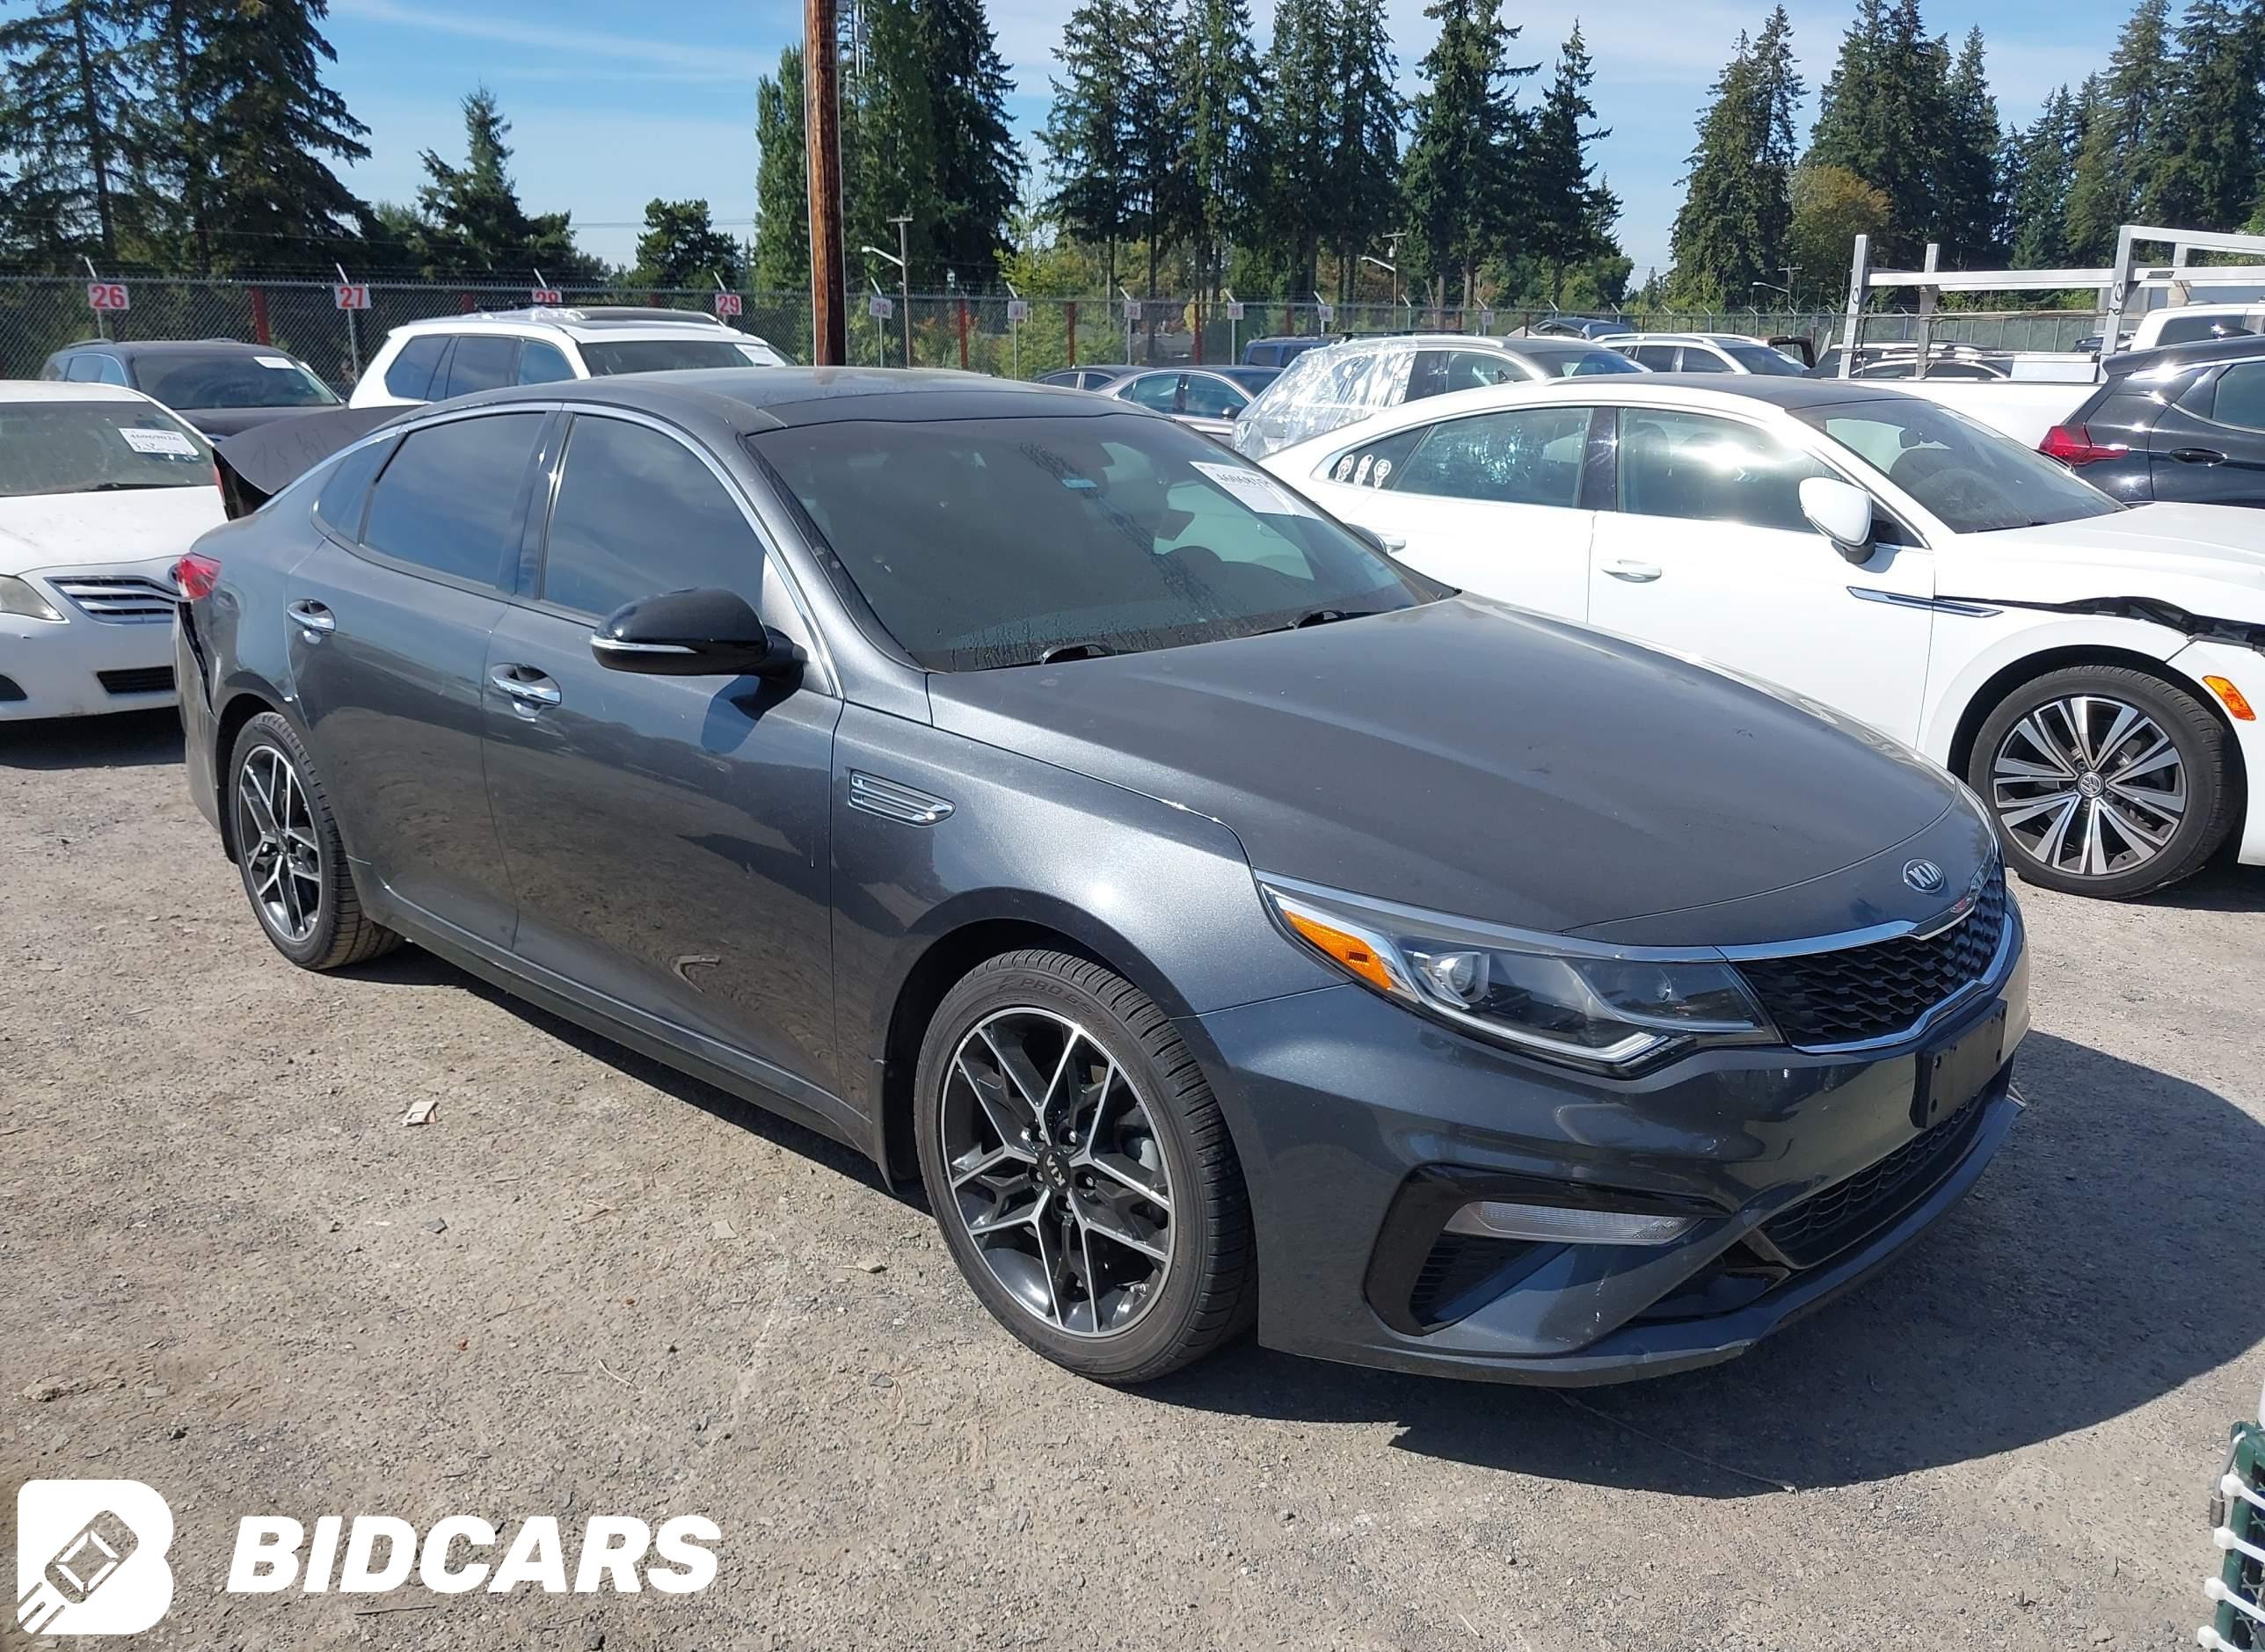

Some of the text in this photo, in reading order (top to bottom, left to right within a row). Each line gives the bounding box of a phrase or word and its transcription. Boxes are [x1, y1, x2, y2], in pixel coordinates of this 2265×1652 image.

[91, 285, 126, 307] 26
[339, 286, 363, 308] 27
[718, 295, 740, 314] 29
[1020, 977, 1063, 996] PRO
[1046, 1153, 1066, 1187] KIA
